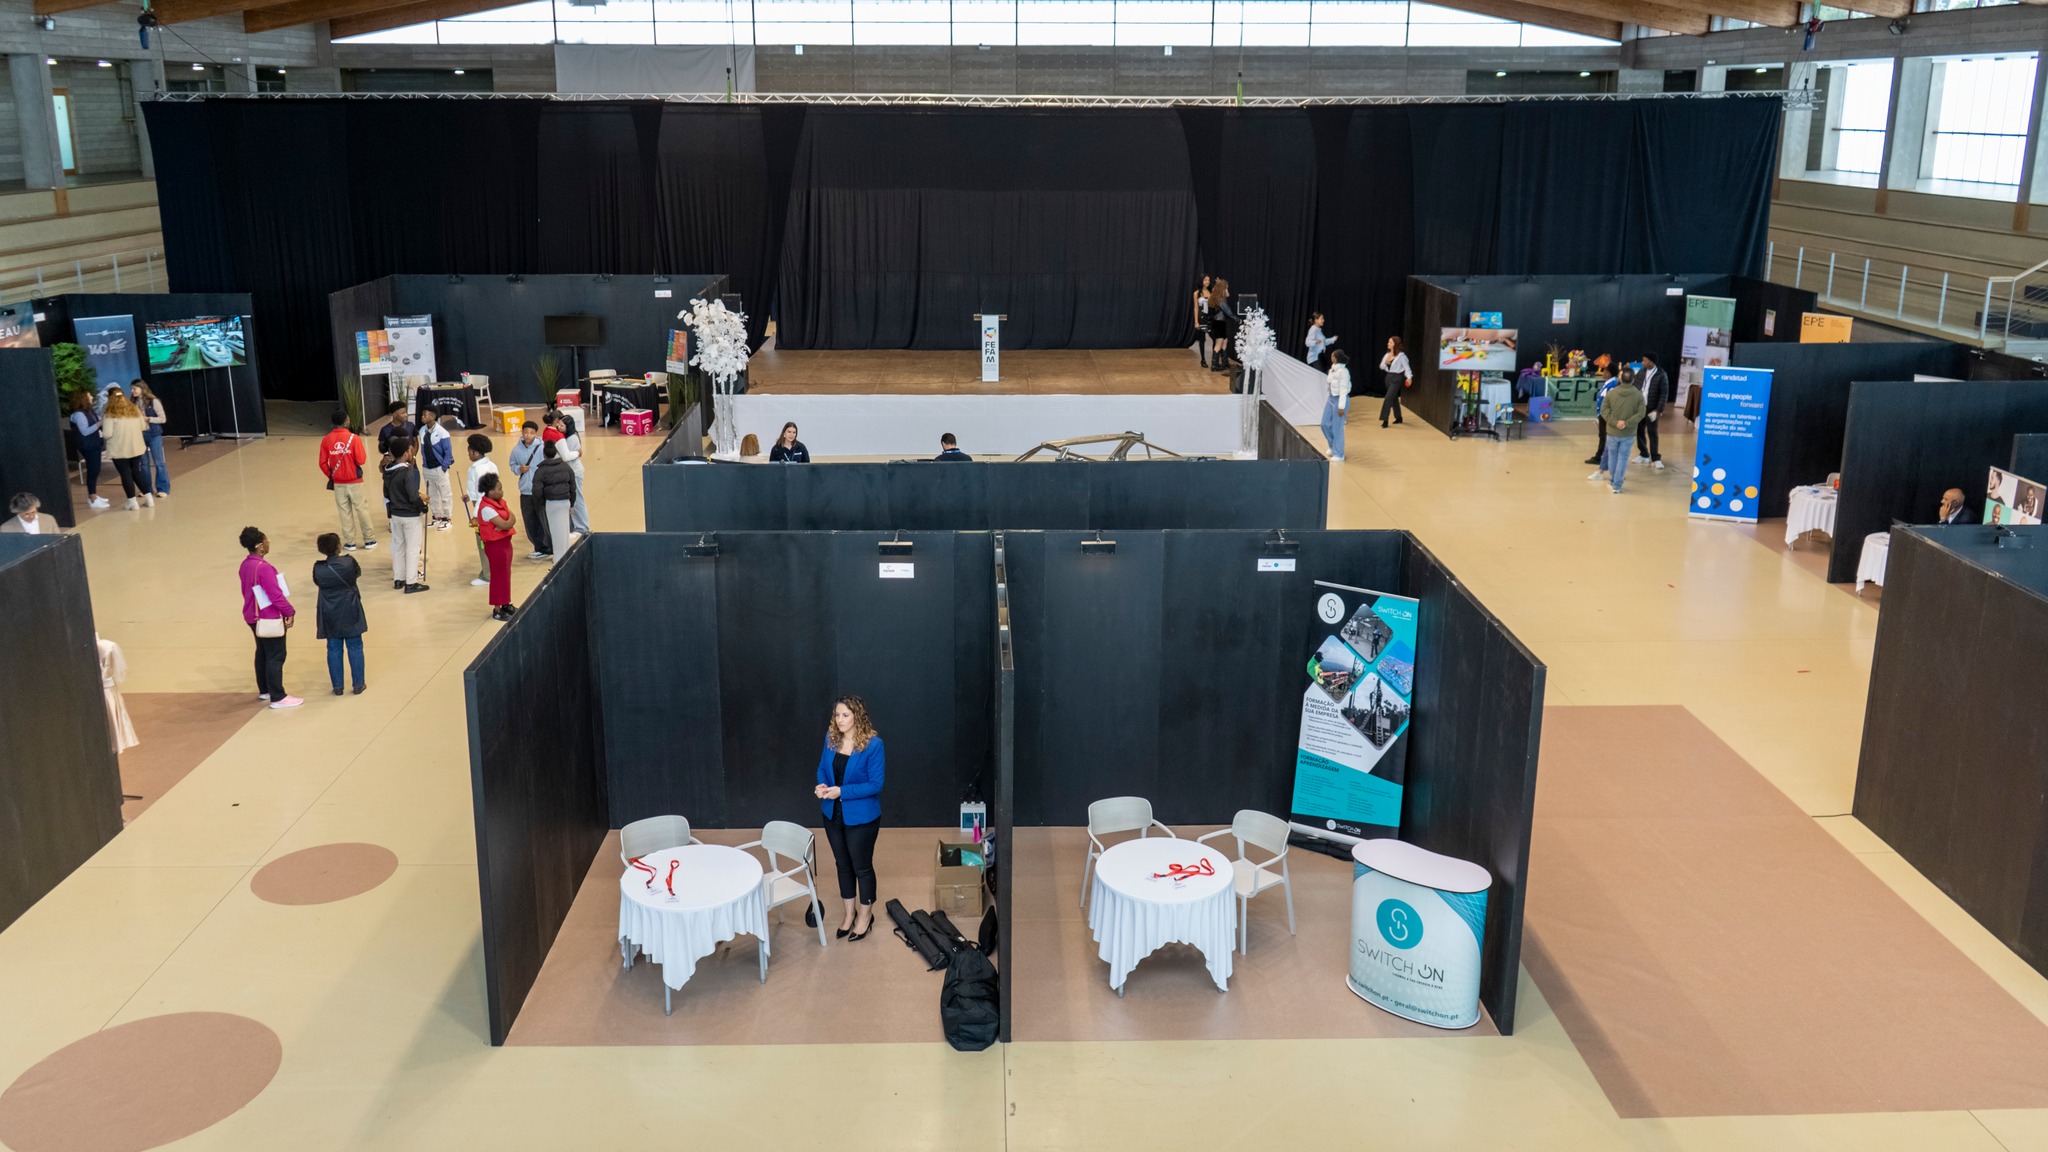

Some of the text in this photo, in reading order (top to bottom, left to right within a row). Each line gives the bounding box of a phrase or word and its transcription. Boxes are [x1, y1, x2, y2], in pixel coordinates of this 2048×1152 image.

[1688, 298, 1709, 309] EPE
[1803, 316, 1825, 327] EPE
[1378, 606, 1401, 615] SWITCH
[1306, 697, 1334, 707] FORMAÇÃO
[1310, 703, 1330, 712] MEDIDA
[1316, 710, 1338, 719] EMPRESA
[1301, 754, 1329, 765] FORMAÇÃO
[1300, 760, 1340, 772] APRENDIZAGEM
[1357, 938, 1413, 976] SWITCH
[1418, 964, 1444, 983] ON
[1394, 1000, 1459, 1020] geral@switchon.pt
